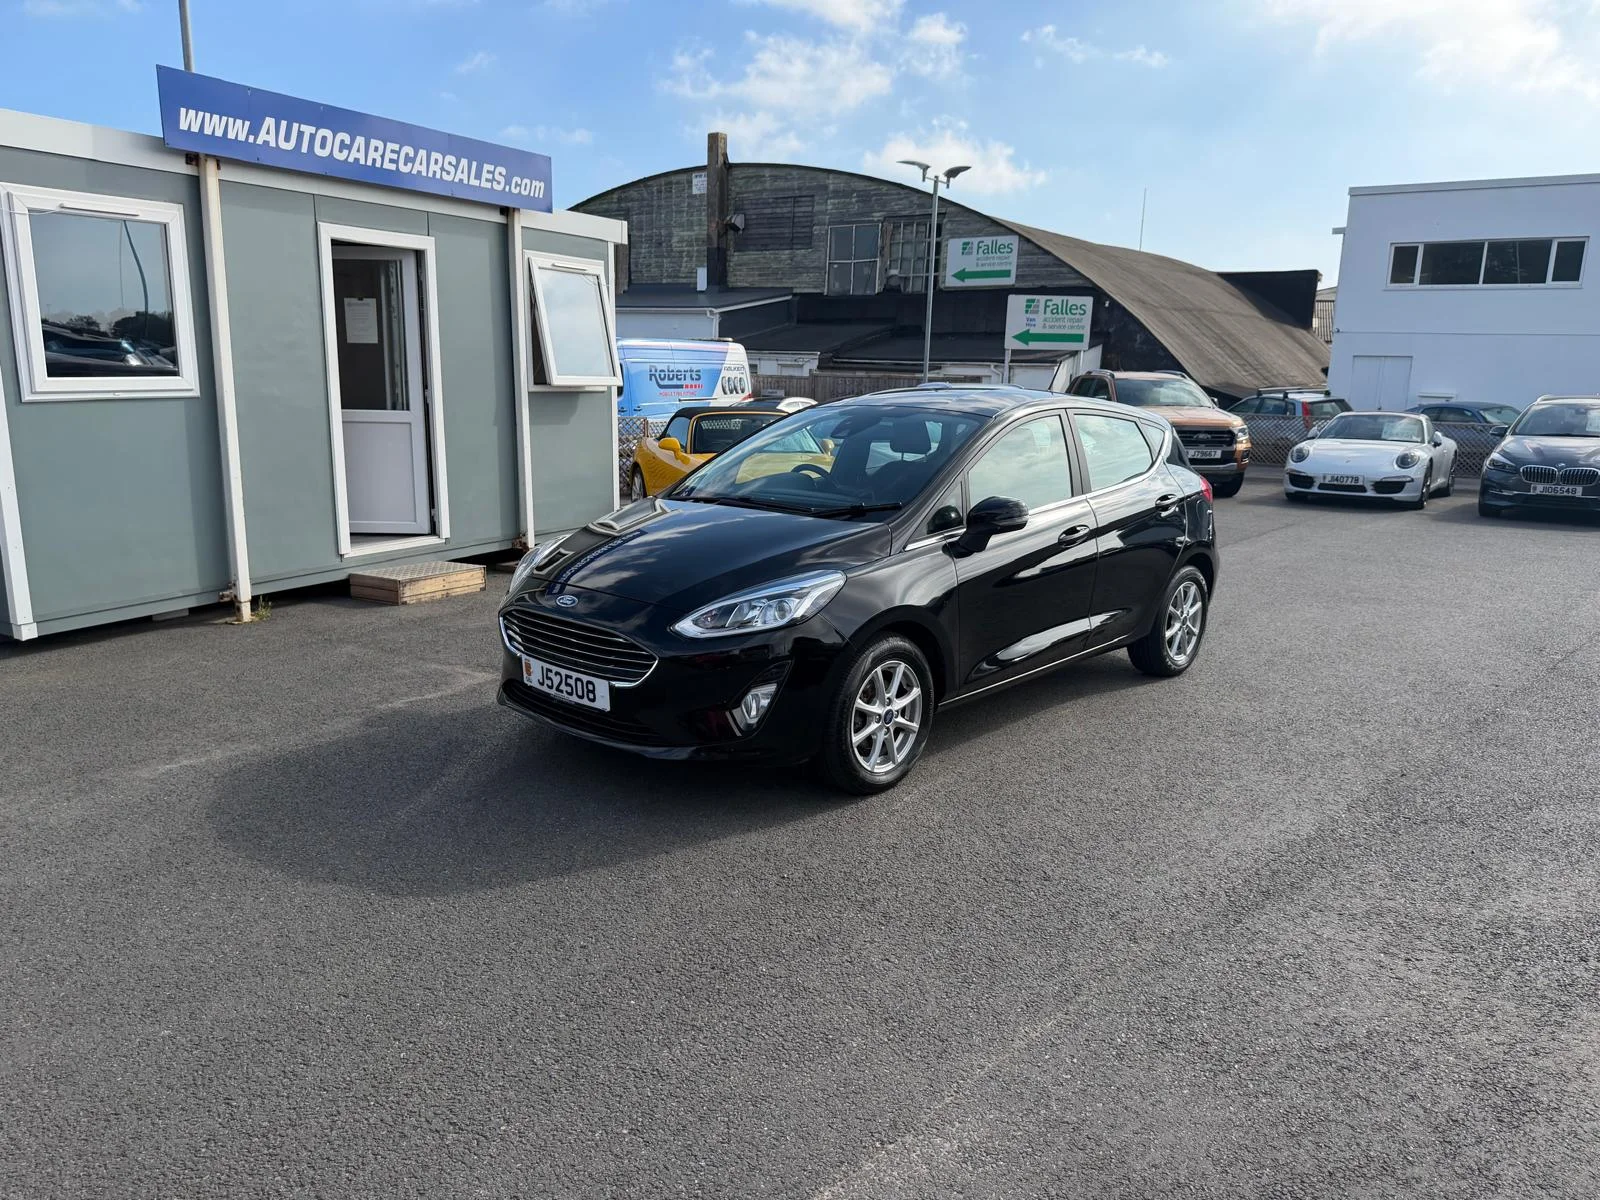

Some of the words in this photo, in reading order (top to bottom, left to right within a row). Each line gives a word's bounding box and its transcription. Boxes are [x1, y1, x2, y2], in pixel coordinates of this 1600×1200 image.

[976, 239, 1014, 255] Falles
[1043, 298, 1087, 316] Falles
[649, 364, 702, 382] Roberts
[1192, 450, 1217, 458] J79667
[1539, 486, 1577, 495] J106548
[537, 665, 597, 703] J52508
